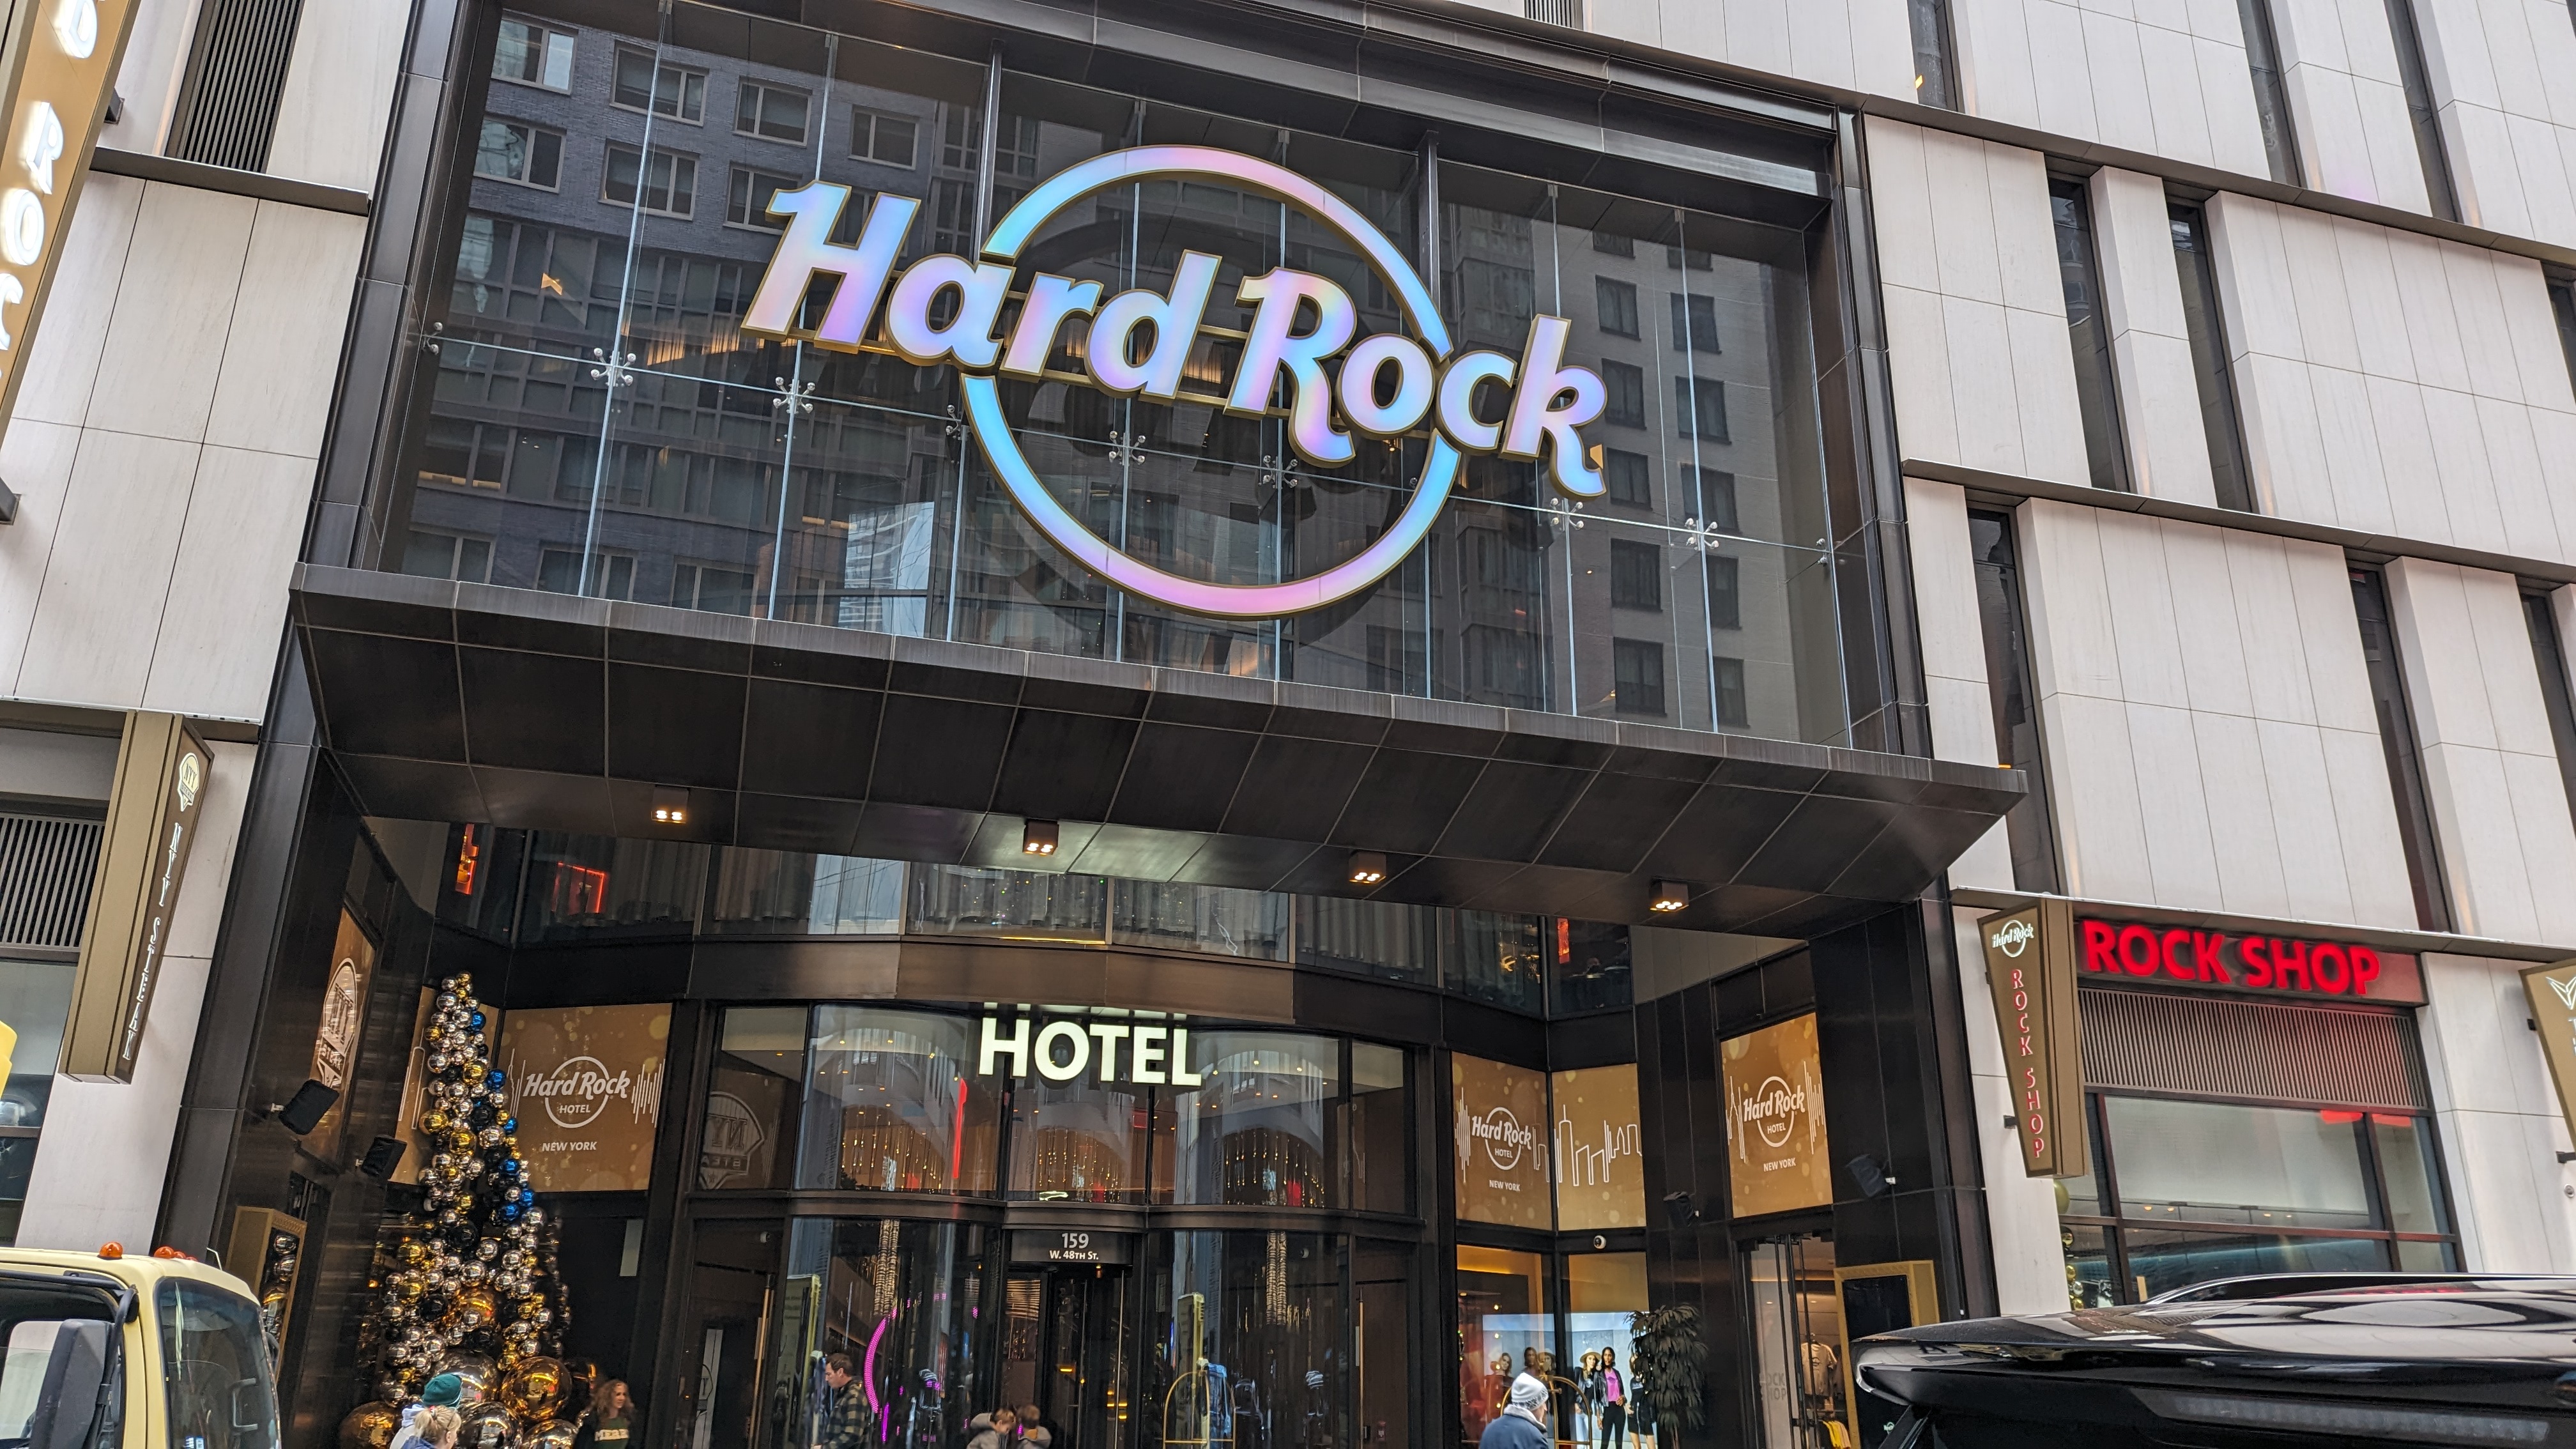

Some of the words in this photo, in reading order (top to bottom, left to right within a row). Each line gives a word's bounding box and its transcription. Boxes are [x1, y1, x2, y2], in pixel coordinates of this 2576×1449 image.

[740, 180, 1222, 404] Hard
[1223, 266, 1608, 501] Rock
[183, 762, 197, 788] NYY
[158, 822, 183, 907] NYY
[1991, 928, 2013, 948] Hard
[2012, 923, 2034, 943] Rock
[2083, 920, 2232, 984] ROCK
[2239, 935, 2380, 995] SHOP
[123, 916, 162, 1061] STEAK
[978, 1017, 1202, 1087] HOTEL
[2011, 969, 2034, 1057] ROCK
[2024, 1067, 2044, 1159] SHOP
[522, 1071, 580, 1097] Hard
[578, 1070, 631, 1100] Rock
[559, 1104, 591, 1114] HOTEL
[1743, 1091, 1774, 1122] Hard
[1774, 1085, 1805, 1118] Rock
[1471, 1115, 1503, 1140] Hard
[1503, 1121, 1532, 1151] Rock
[1767, 1122, 1786, 1135] HOTEL
[542, 1142, 568, 1151] NEW
[569, 1141, 597, 1151] YORK
[1494, 1147, 1513, 1159] HOTEL
[1763, 1162, 1779, 1172] NEW
[1779, 1157, 1797, 1169] YORK
[1489, 1179, 1504, 1190] NEW
[1505, 1182, 1521, 1192] YORK
[1061, 1232, 1089, 1249] 159
[1049, 1250, 1062, 1259] W.
[1062, 1250, 1086, 1260] 48TH
